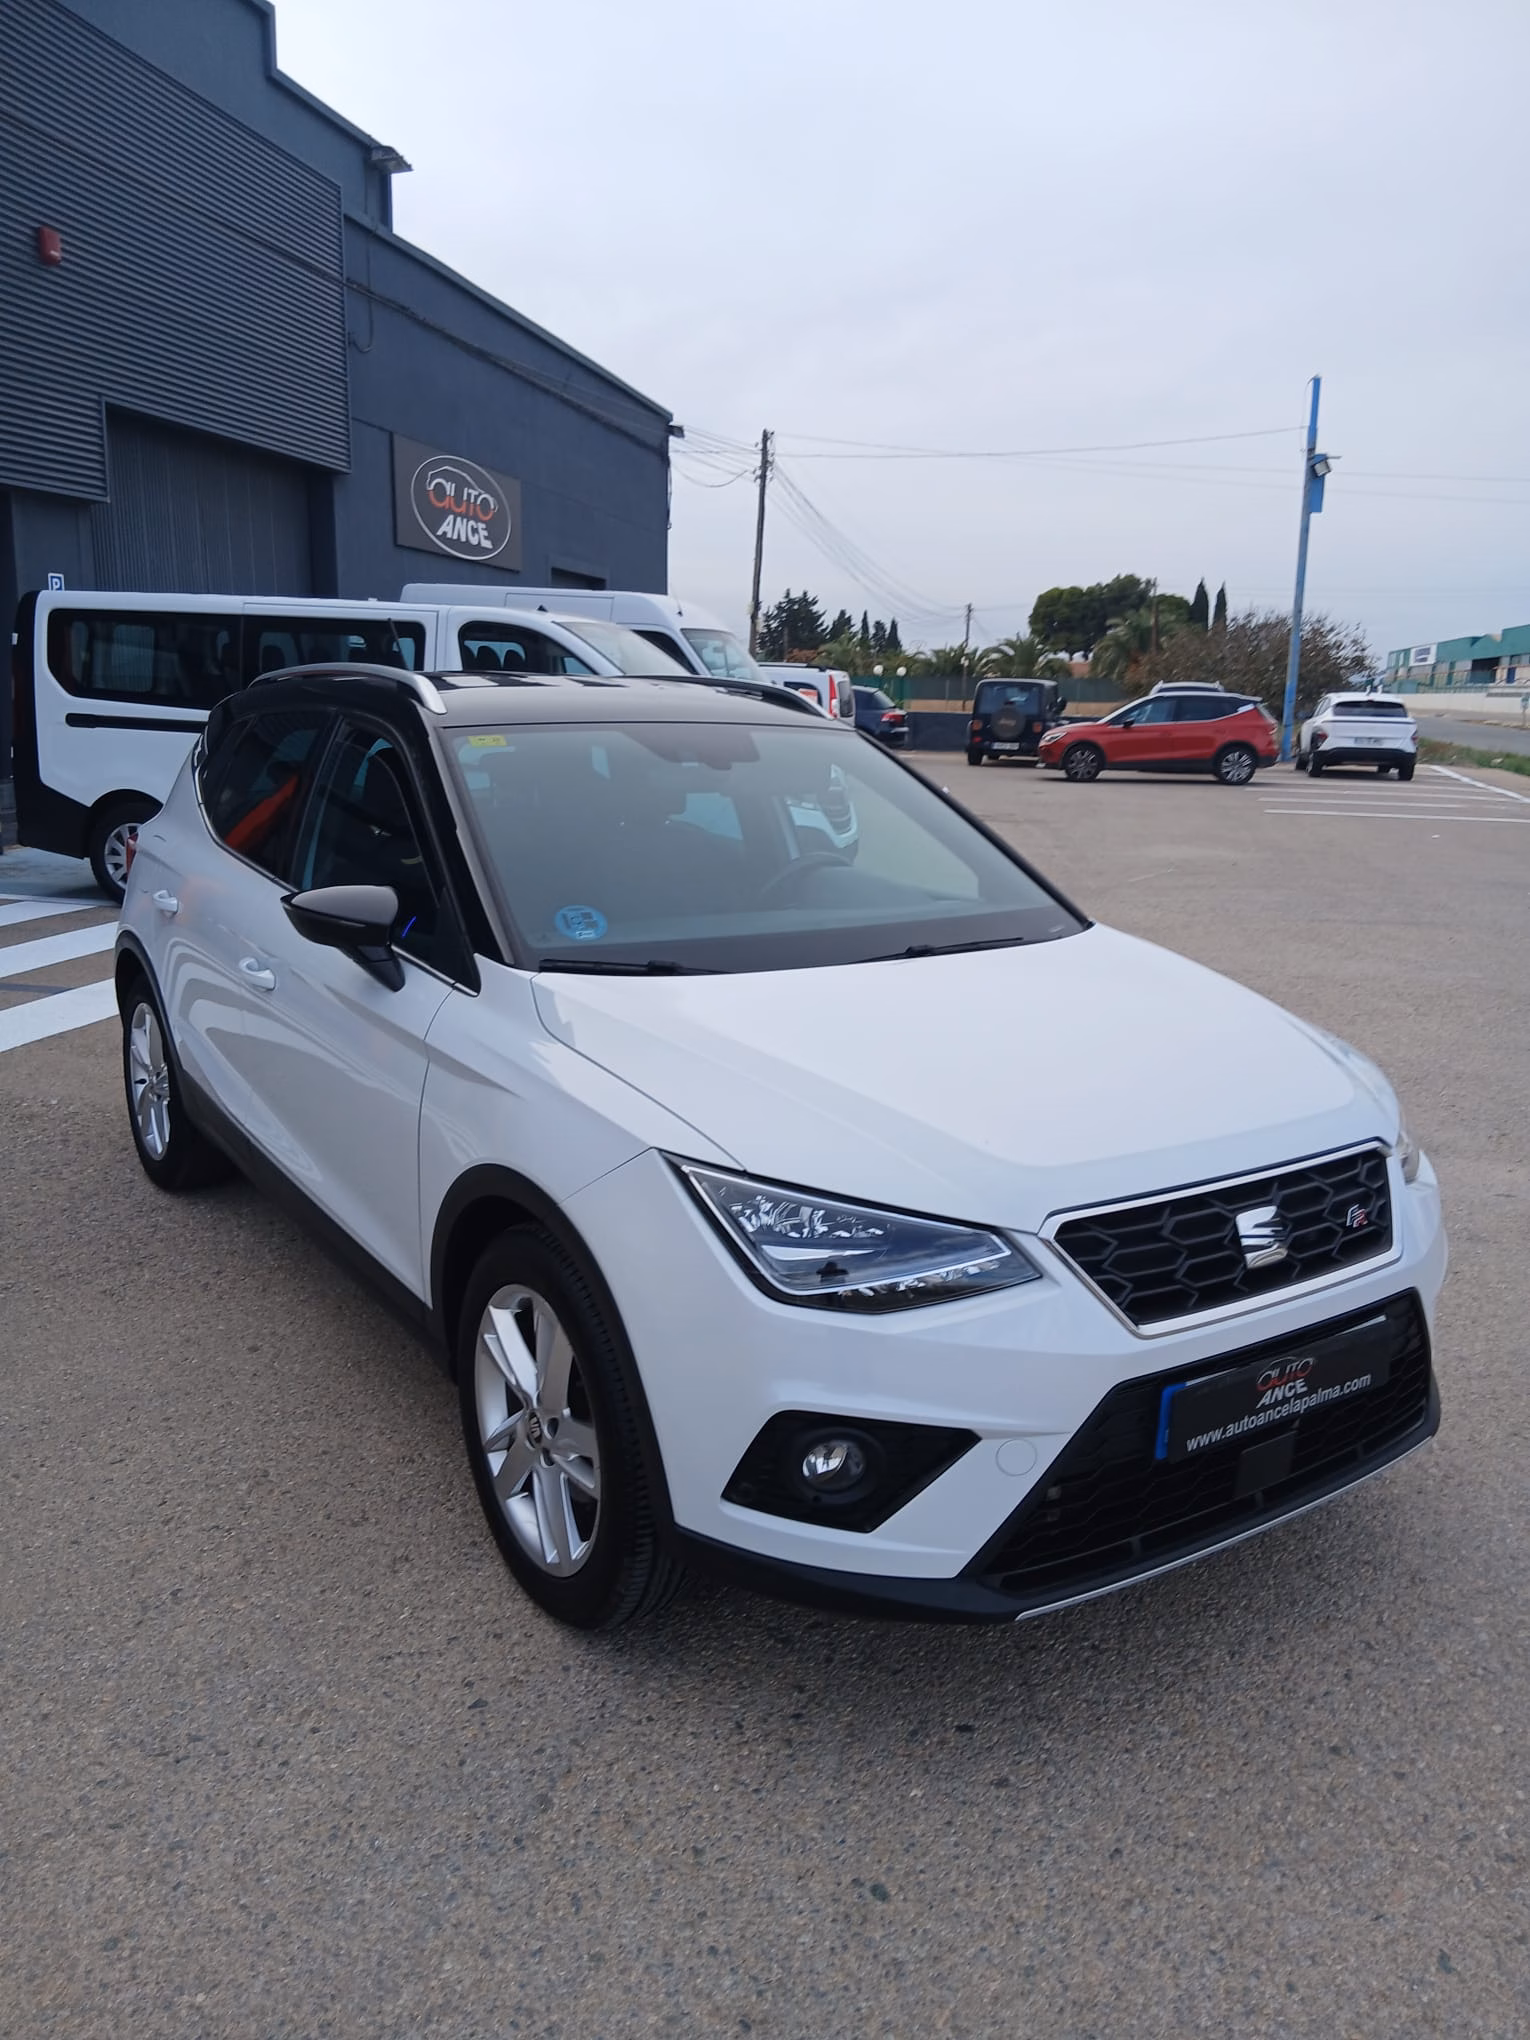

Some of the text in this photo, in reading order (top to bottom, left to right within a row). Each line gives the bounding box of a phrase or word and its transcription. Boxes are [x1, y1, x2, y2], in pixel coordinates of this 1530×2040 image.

[436, 514, 493, 549] ANCE
[52, 578, 60, 591] P
[1256, 1378, 1308, 1409] ANCE
[1186, 1373, 1371, 1452] www.autoancelapalma.com
